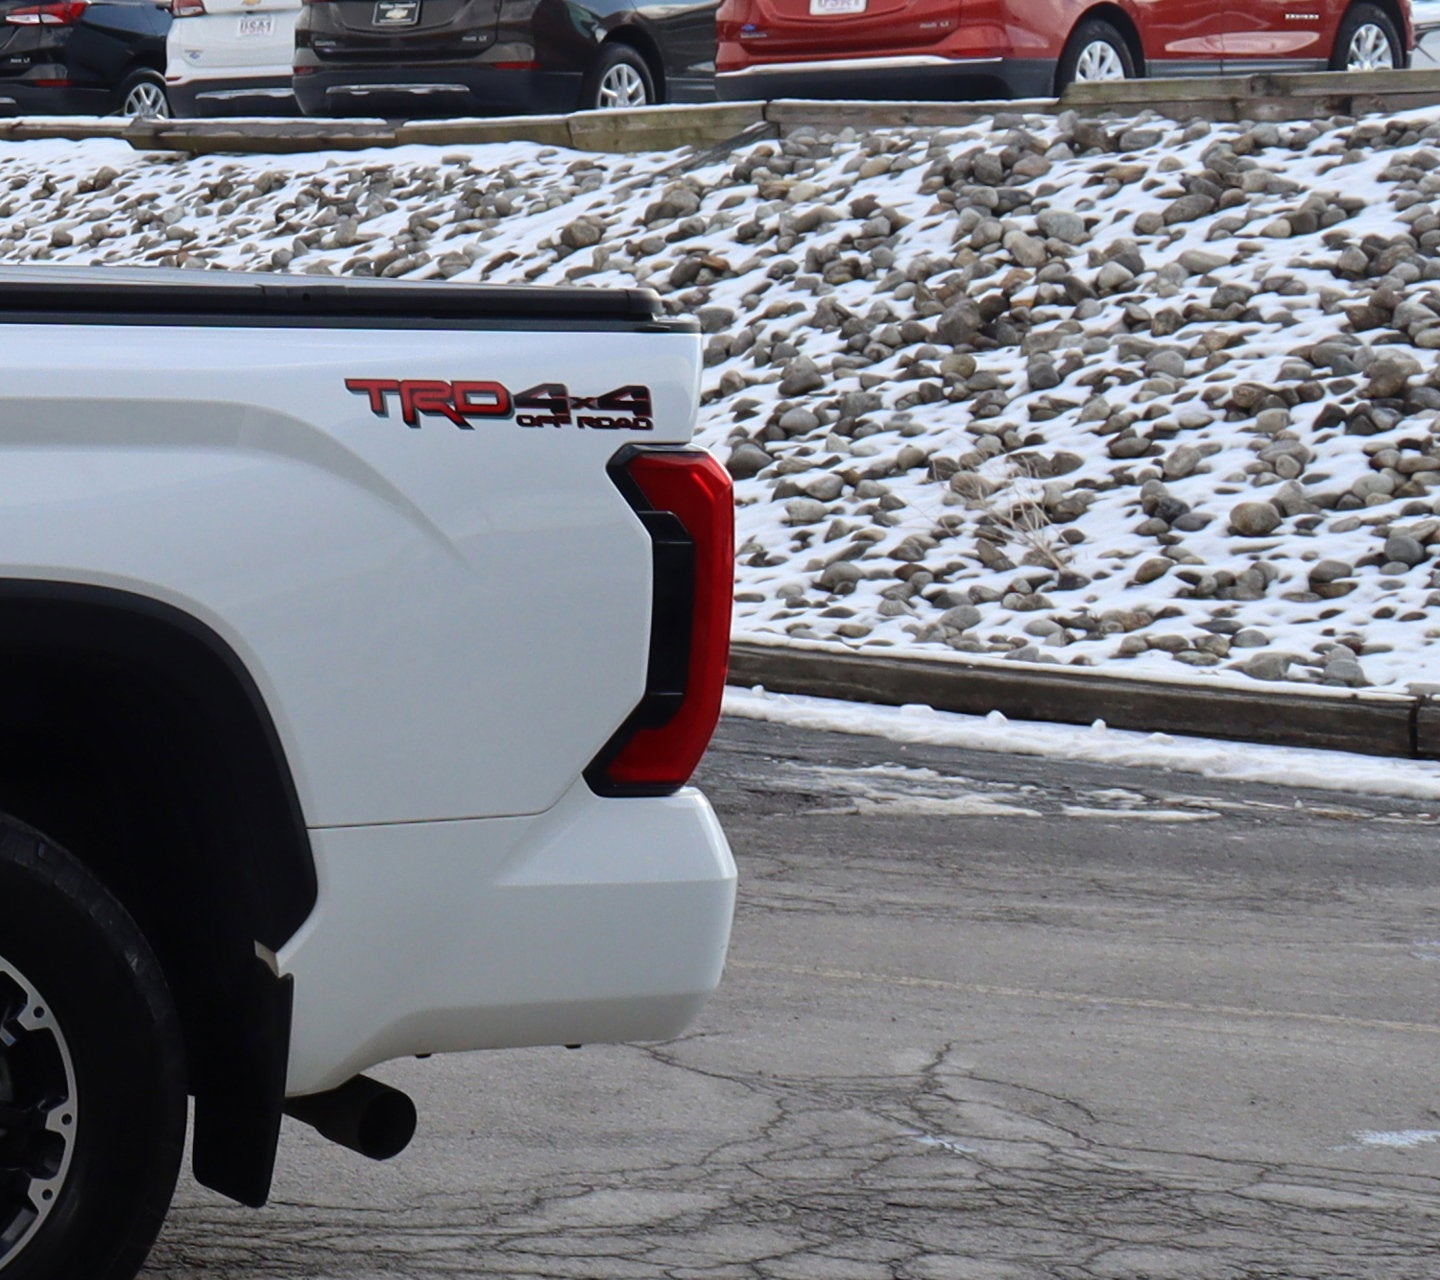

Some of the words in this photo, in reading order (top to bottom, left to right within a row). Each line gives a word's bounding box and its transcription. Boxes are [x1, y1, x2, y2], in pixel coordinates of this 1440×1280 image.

[240, 20, 272, 33] USA1
[344, 378, 515, 431] TRD
[512, 382, 654, 418] 4x4
[516, 414, 573, 429] OFF
[577, 415, 654, 431] ROAD
